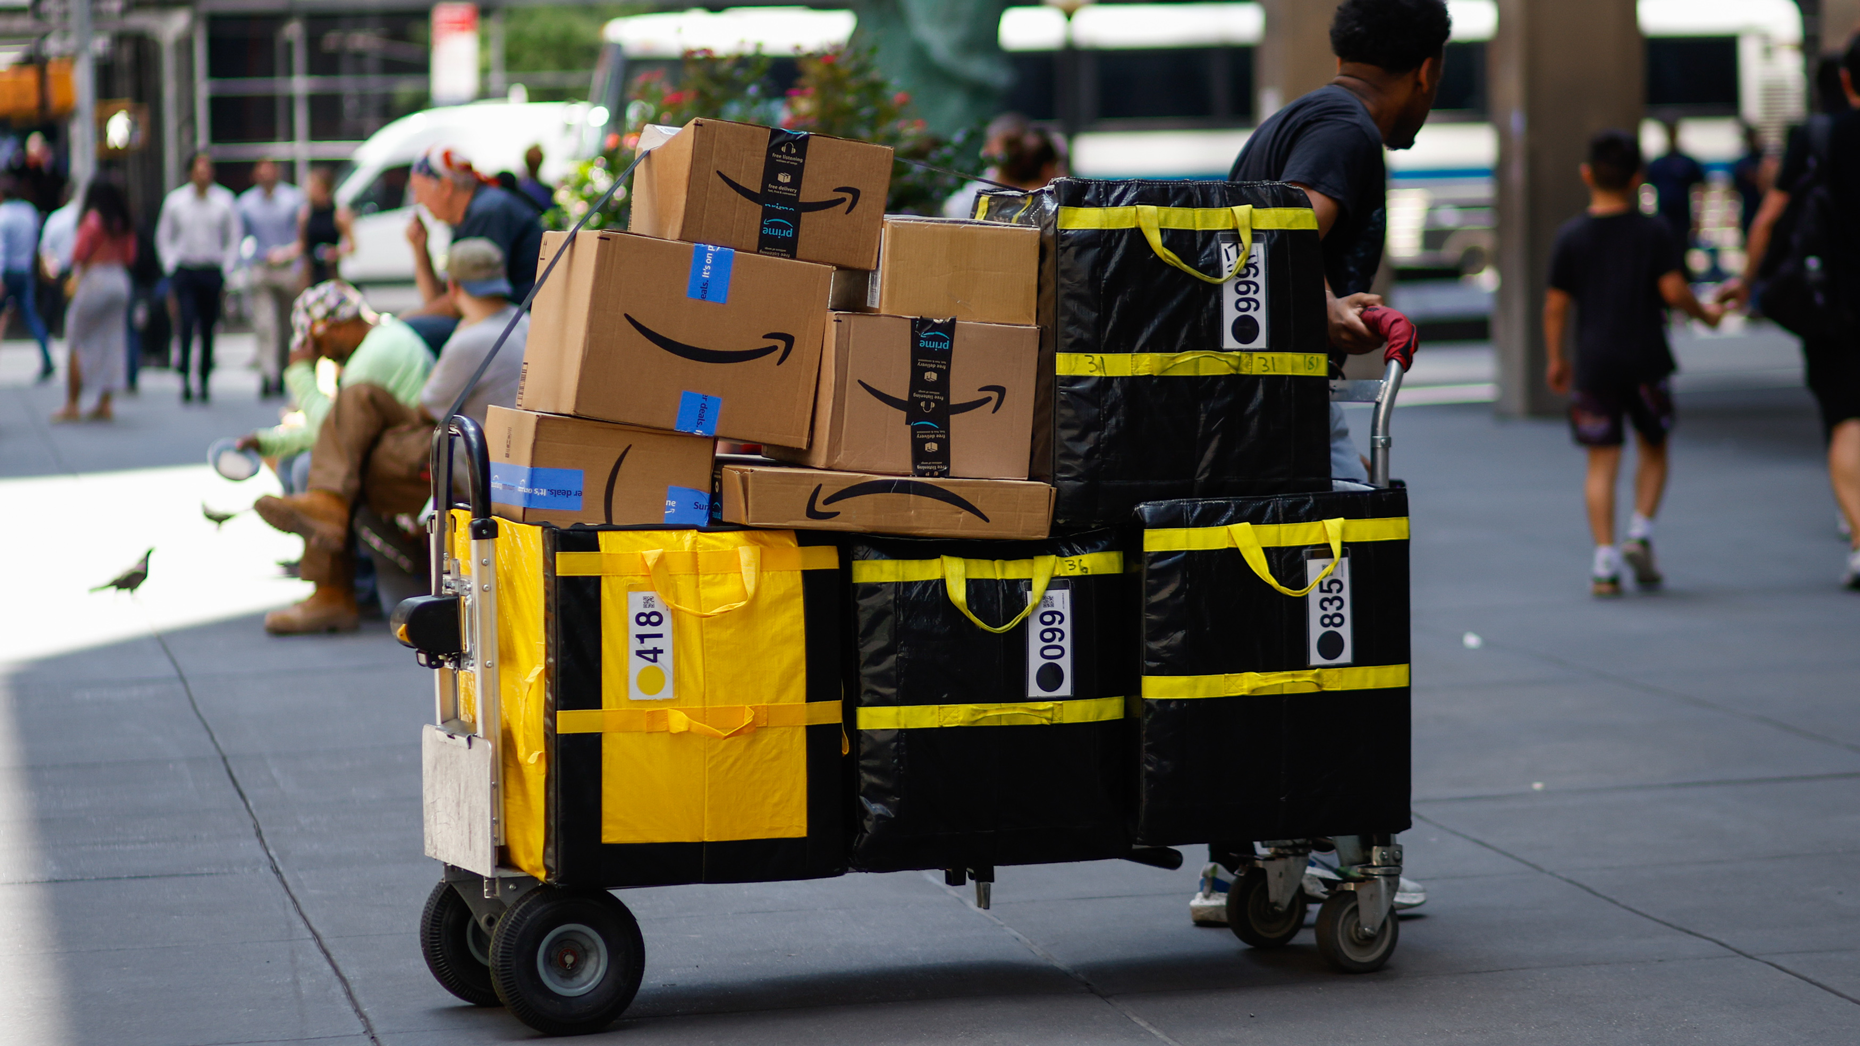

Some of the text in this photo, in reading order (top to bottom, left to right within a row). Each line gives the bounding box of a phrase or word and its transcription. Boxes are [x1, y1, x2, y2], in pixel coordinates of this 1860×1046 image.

[778, 185, 797, 193] delivery
[762, 227, 793, 239] prime
[705, 252, 713, 264] on
[702, 265, 711, 278] It's
[1234, 262, 1261, 313] 999
[919, 340, 950, 351] prime
[1084, 354, 1107, 377] 31
[1258, 356, 1276, 373] 31
[696, 403, 708, 428] deals.
[534, 487, 547, 496] It's
[547, 488, 572, 498] deals.
[1065, 558, 1089, 574] 36
[1319, 578, 1345, 628] 835
[635, 611, 664, 663] 418
[1039, 610, 1065, 660] 099
